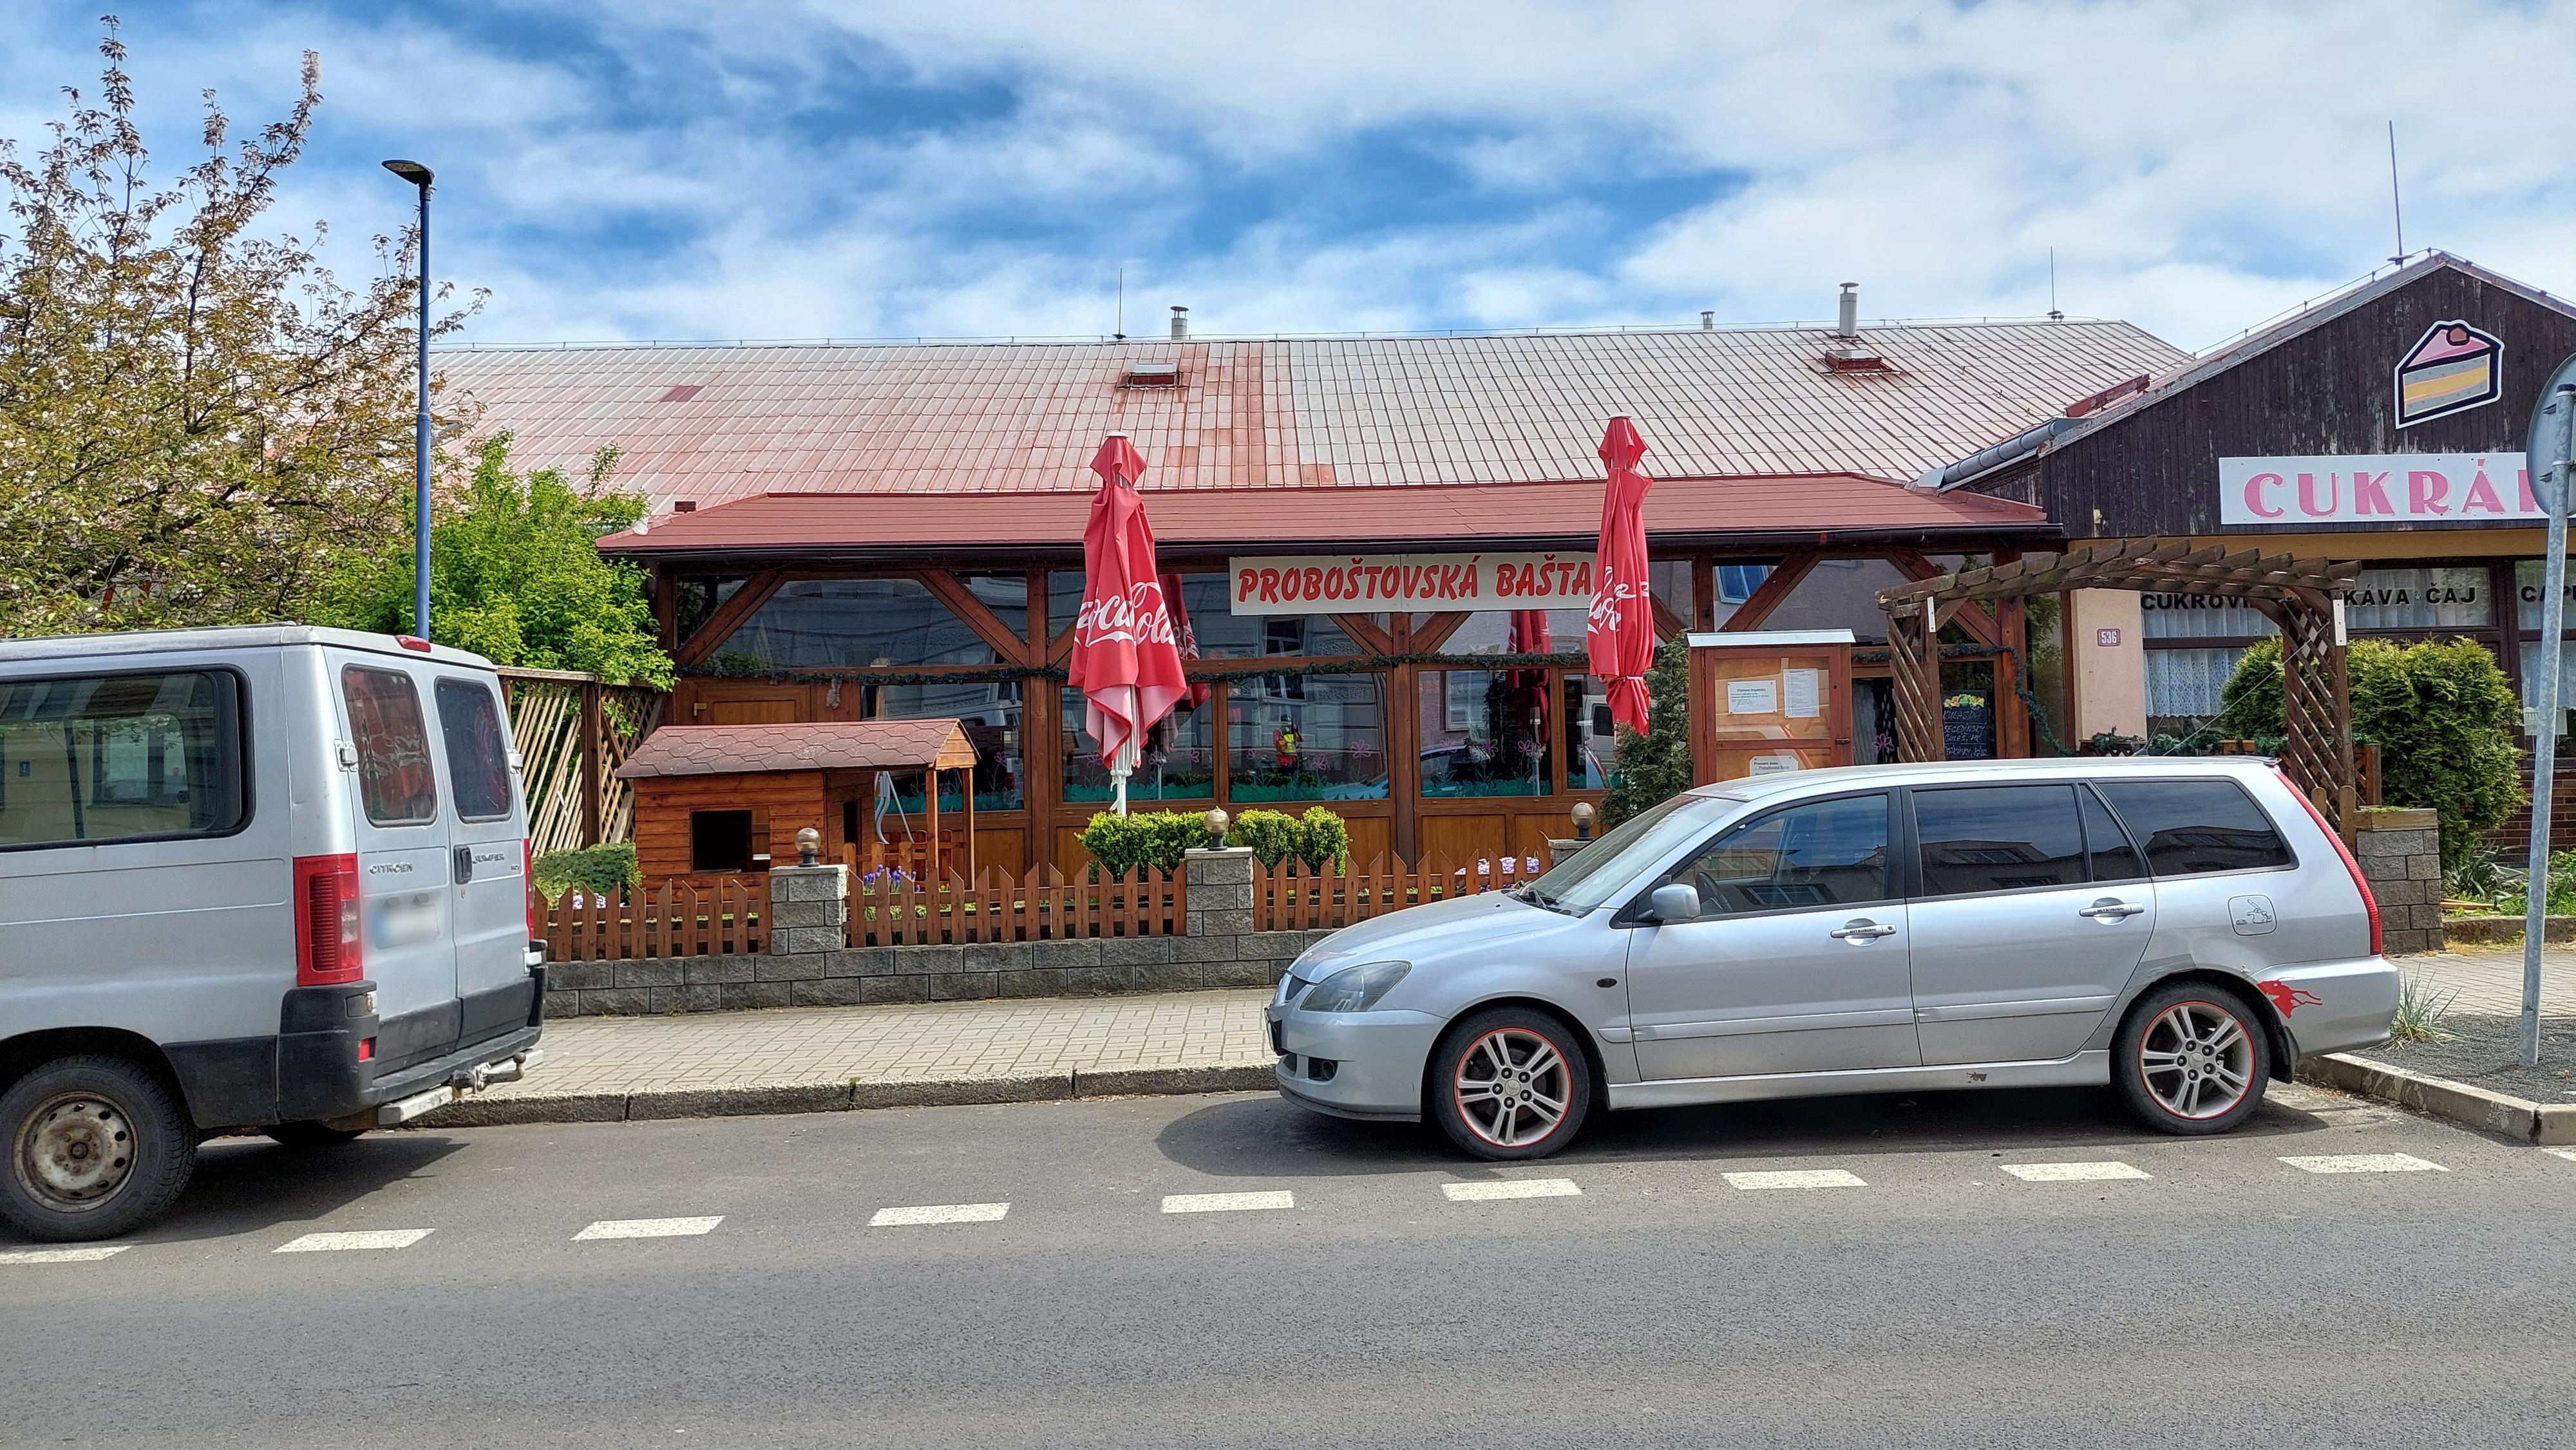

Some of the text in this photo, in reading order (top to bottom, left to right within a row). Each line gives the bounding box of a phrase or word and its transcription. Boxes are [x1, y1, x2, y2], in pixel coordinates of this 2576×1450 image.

[1238, 554, 1591, 605] PROBOŠTOVSKÁ BAŠTA
[2343, 582, 2476, 607] KÁVA ČAJ
[2101, 631, 2117, 644] 536
[472, 853, 505, 864] JUMPER
